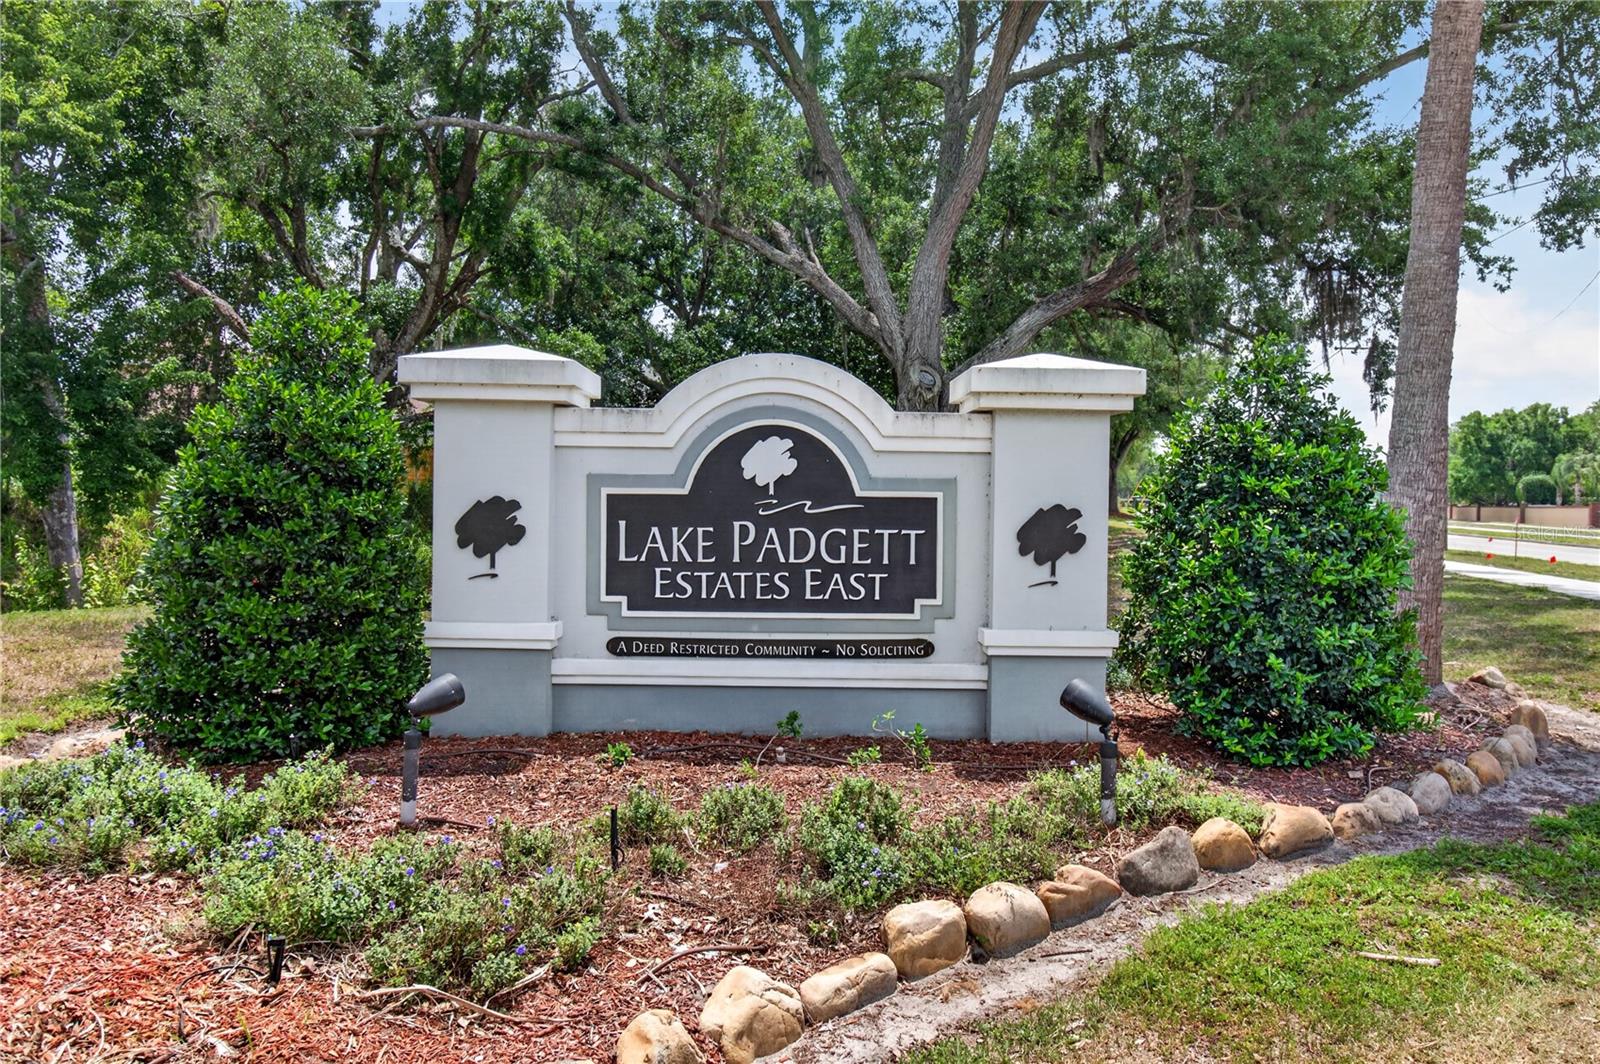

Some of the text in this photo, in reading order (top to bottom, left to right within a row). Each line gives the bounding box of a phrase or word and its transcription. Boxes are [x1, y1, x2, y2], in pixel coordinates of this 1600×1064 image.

[618, 520, 926, 565] LAKE PADGETT
[654, 567, 888, 601] ESTATES EAST
[616, 641, 627, 653] A
[632, 641, 665, 654] DEED
[670, 641, 740, 655] RESTRICTED
[745, 642, 817, 656] COMMUNITY
[836, 643, 855, 656] NO
[860, 644, 924, 656] SOLICITING
